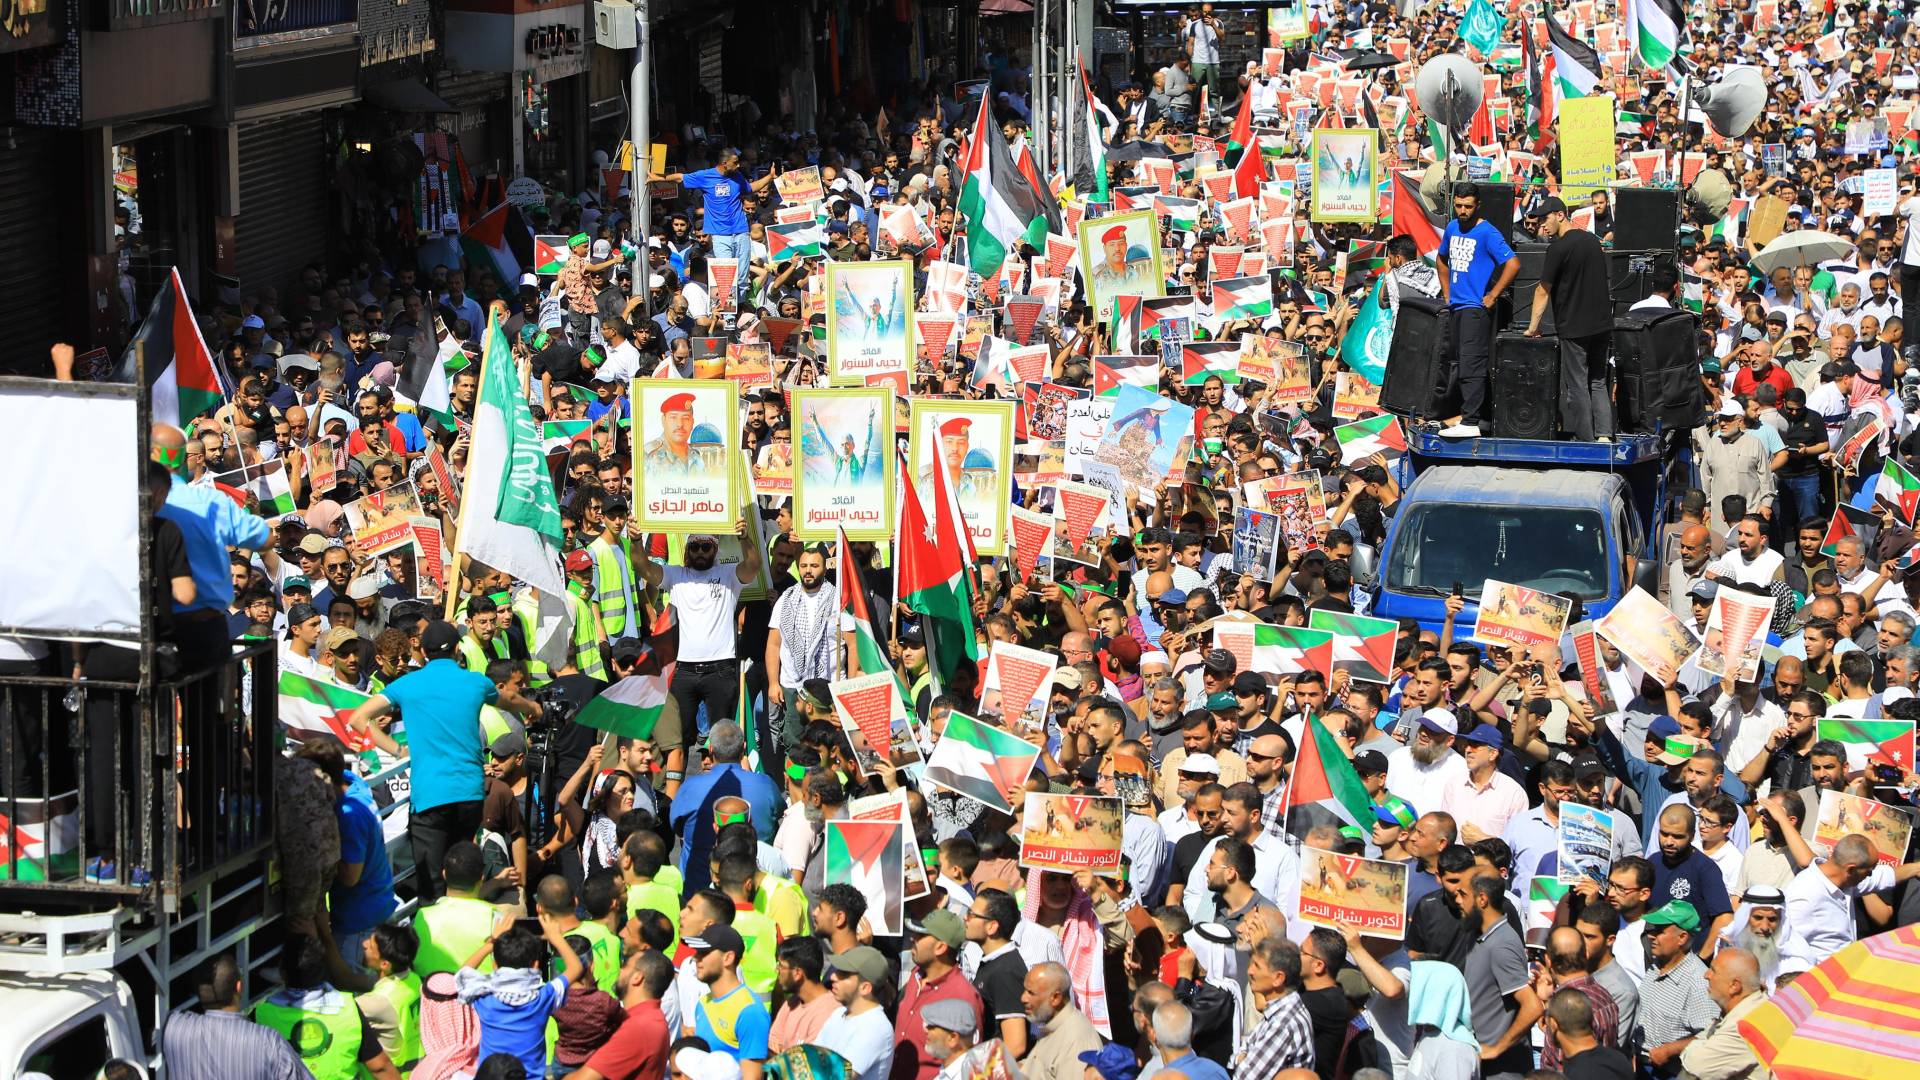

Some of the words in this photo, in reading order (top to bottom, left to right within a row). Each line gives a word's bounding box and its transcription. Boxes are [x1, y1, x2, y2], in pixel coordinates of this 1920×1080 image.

[1449, 235, 1477, 249] KILLER
[840, 358, 874, 371] السنوار
[876, 359, 902, 369] يحيى
[1069, 405, 1094, 418] العدو
[784, 445, 792, 456] 7
[1069, 441, 1095, 456] كان
[777, 479, 792, 488] شائر
[1278, 476, 1286, 488] 7
[374, 494, 381, 506] 7
[831, 495, 855, 505] القائد
[648, 499, 687, 515] الجازي
[690, 500, 724, 515] ماهر
[807, 508, 846, 524] السنوار
[849, 509, 880, 523] يحيى
[381, 530, 401, 543] بشائر
[969, 524, 992, 538] ماه
[361, 537, 380, 549] النص
[1521, 589, 1531, 602] 7
[1480, 625, 1503, 636] النصر
[1503, 630, 1528, 642] بشائر
[1073, 797, 1084, 815] 7
[1865, 801, 1877, 817] 7
[1024, 849, 1056, 861] النصر
[1057, 851, 1089, 865] بشائر
[1091, 850, 1118, 867] أكتوبر
[1344, 857, 1356, 875] 7
[1302, 902, 1330, 917] النصر
[1331, 911, 1363, 923] بشائر
[1366, 913, 1399, 928] أكتوبر
